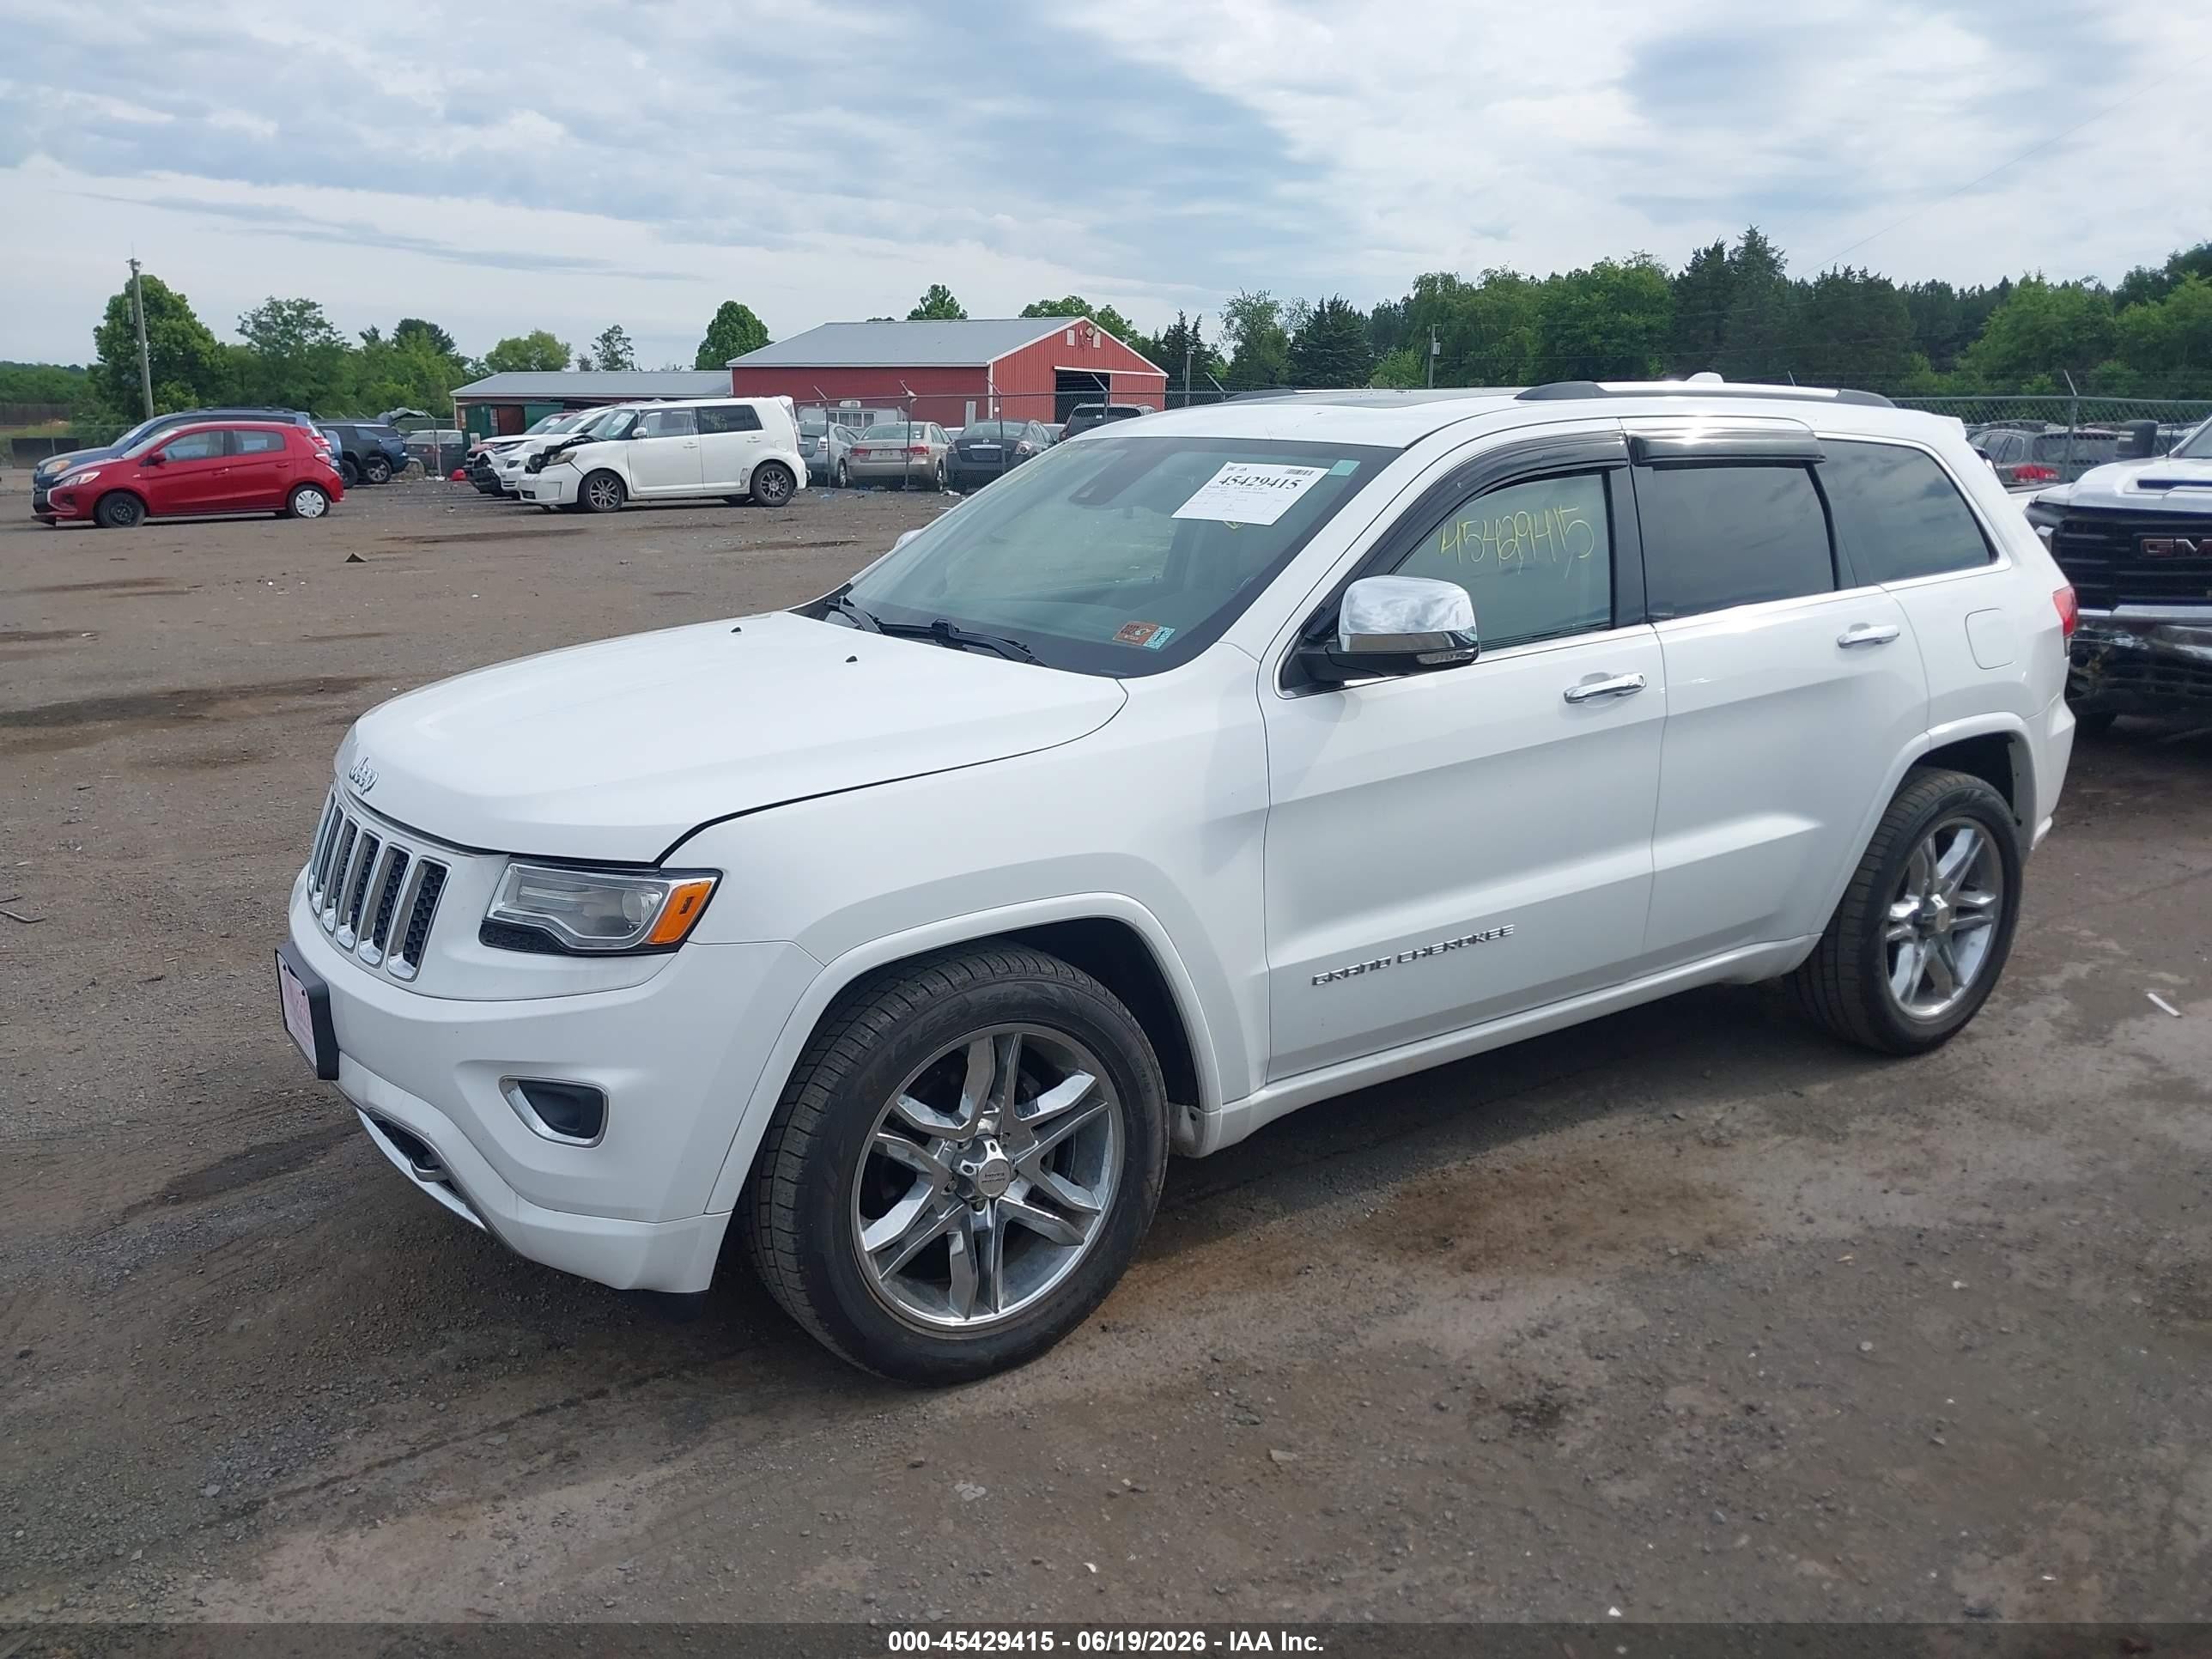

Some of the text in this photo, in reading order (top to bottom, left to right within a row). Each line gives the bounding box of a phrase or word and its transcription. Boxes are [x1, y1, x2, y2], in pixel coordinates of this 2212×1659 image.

[1218, 474, 1303, 490] 45429415
[1439, 504, 1595, 568] 45429415
[349, 756, 380, 796] Jeep
[1311, 924, 1516, 986] GRAND CHEROKEE
